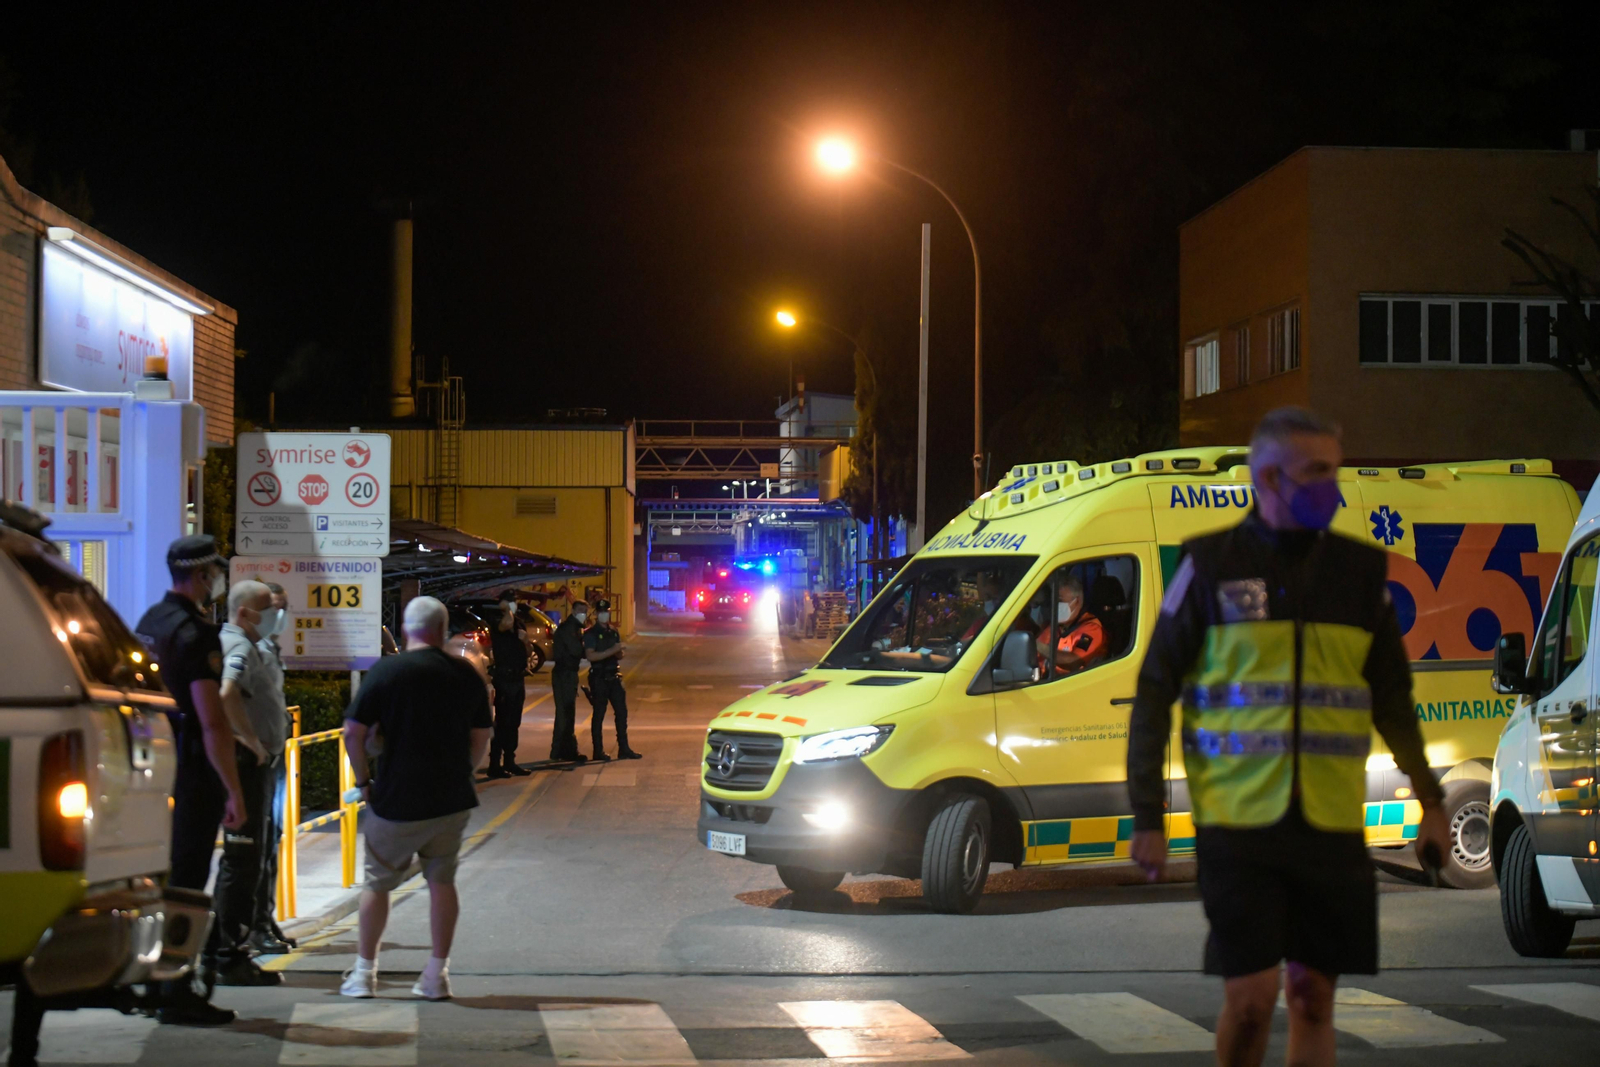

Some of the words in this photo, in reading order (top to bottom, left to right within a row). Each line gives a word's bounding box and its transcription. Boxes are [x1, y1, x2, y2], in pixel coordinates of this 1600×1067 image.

[256, 444, 336, 468] symrise
[300, 482, 328, 497] STOP
[351, 482, 373, 499] 20
[259, 515, 291, 523] CONTROL
[318, 517, 328, 529] P
[261, 537, 289, 546] FÁBRICA
[331, 539, 369, 547] RECEPCIÓN
[235, 562, 274, 573] symrise
[295, 561, 377, 573] ¡BIENVENIDO!
[311, 585, 361, 608] 103
[296, 617, 322, 628] 584
[297, 632, 302, 641] 1
[296, 645, 303, 655] 0
[1415, 697, 1516, 722] ANITARIAS
[1040, 726, 1082, 735] Emergencias
[1083, 723, 1115, 732] Sanitarias
[1116, 722, 1128, 730] 061
[1109, 731, 1128, 739] Salud
